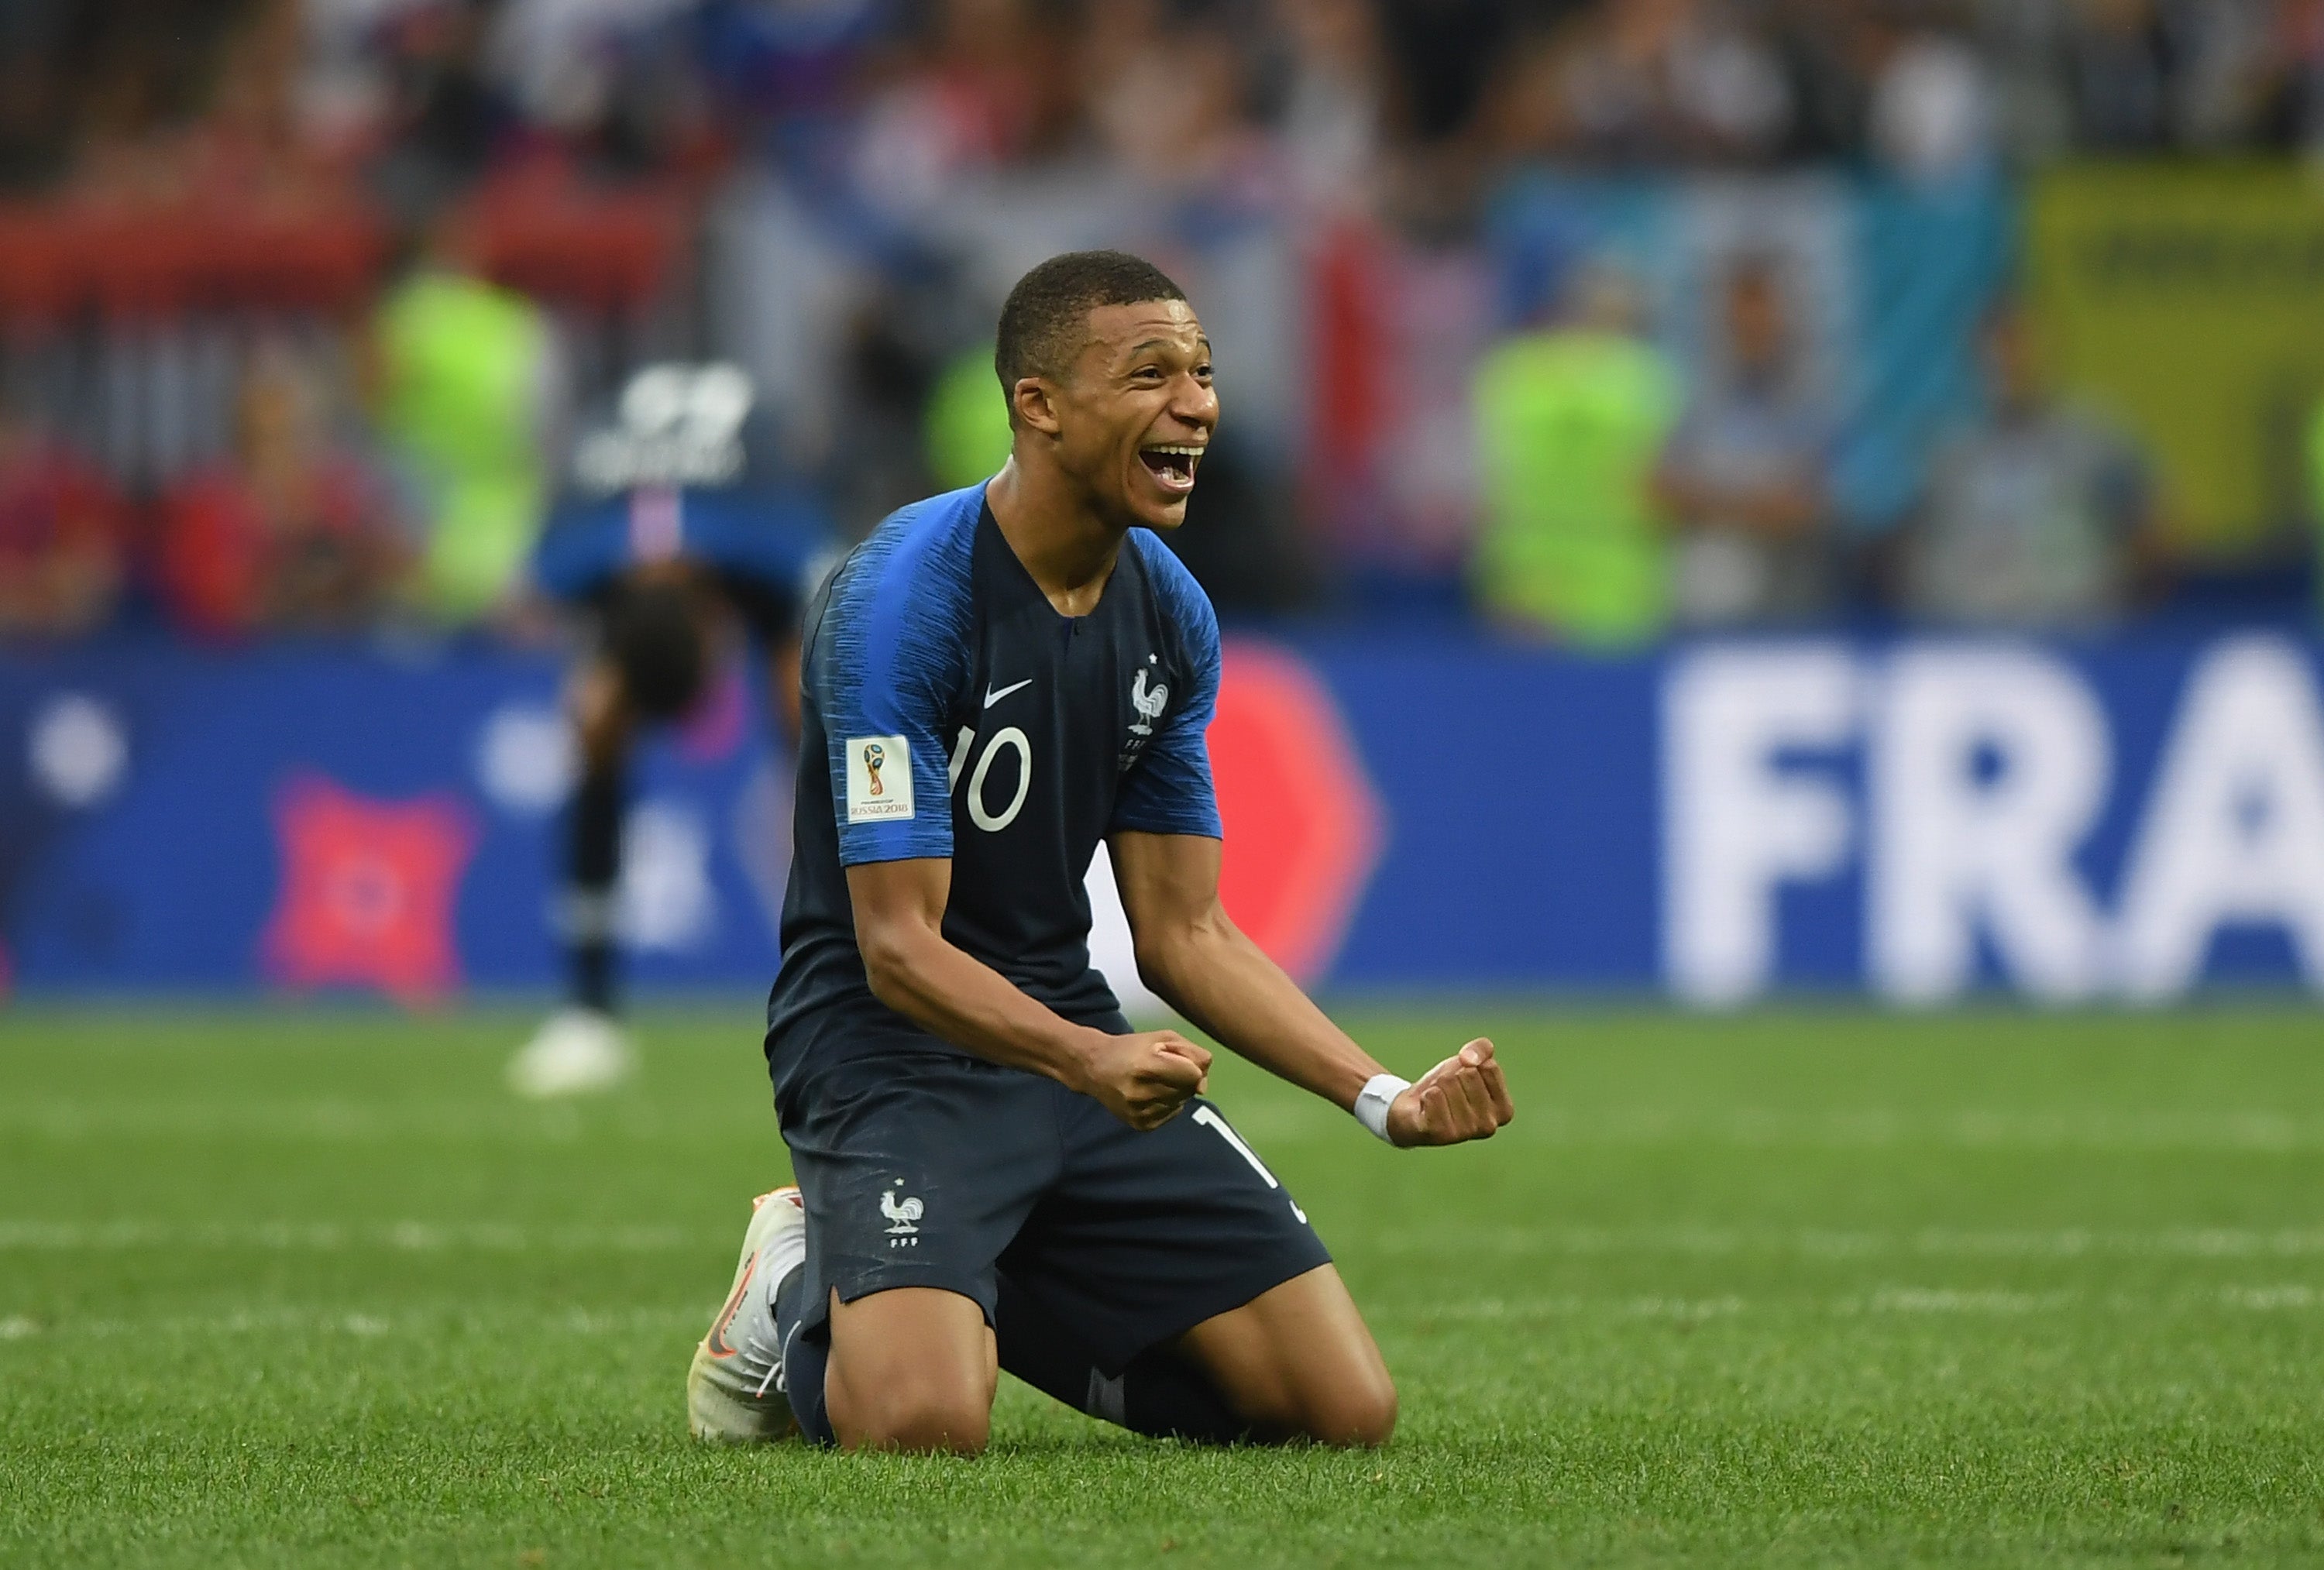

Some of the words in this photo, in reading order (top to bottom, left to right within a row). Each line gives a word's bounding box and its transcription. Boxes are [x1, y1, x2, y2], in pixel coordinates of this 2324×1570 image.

[884, 804, 909, 813] 2018
[948, 725, 1032, 832] 10
[1660, 631, 2324, 1008] FRA
